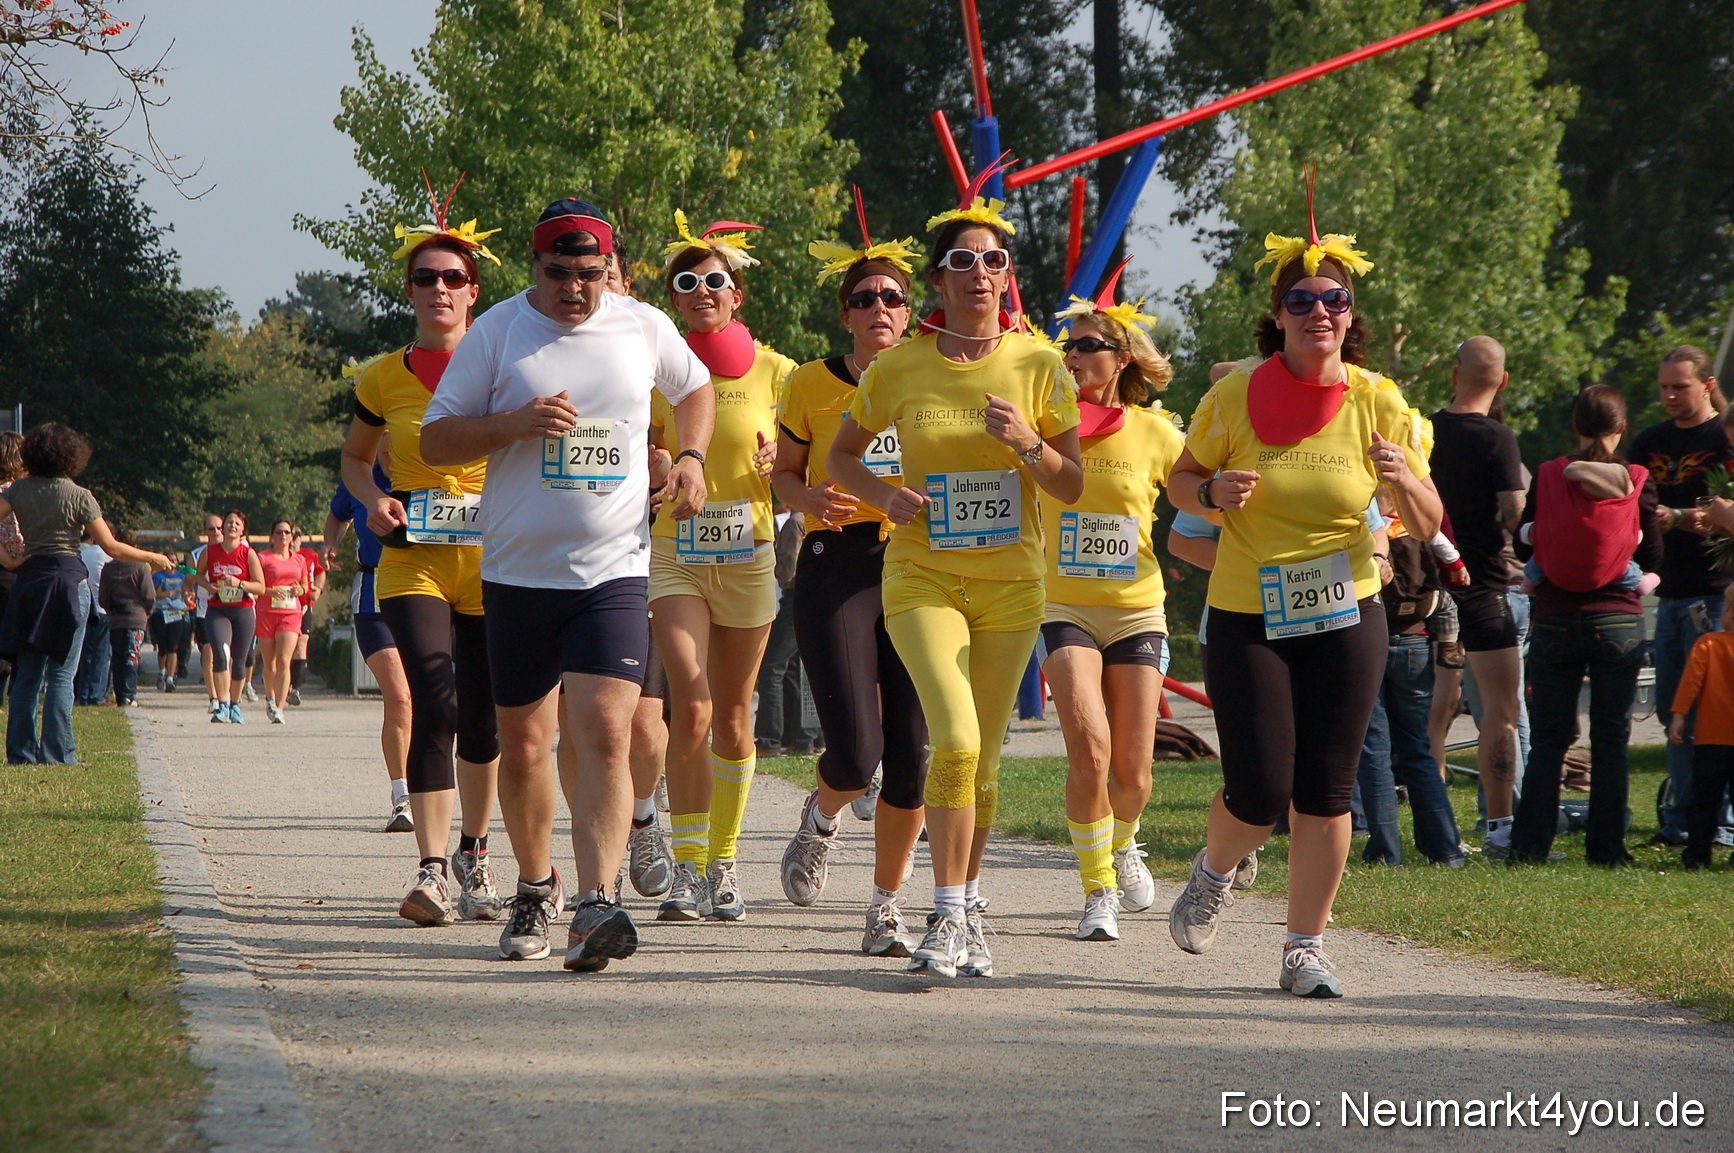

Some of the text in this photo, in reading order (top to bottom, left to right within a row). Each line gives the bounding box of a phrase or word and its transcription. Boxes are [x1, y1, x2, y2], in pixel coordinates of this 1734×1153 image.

[915, 408, 986, 420] BRIGITTEK
[569, 425, 610, 438] Günther
[549, 444, 554, 453] D
[870, 435, 902, 454] 20
[569, 446, 620, 466] 2796
[1258, 450, 1353, 469] BRIGITTEKARL
[953, 478, 1001, 493] Johanna
[413, 504, 419, 512] C
[431, 505, 480, 523] 2717
[697, 505, 743, 519] Alexandra
[934, 501, 939, 512] D
[955, 498, 1012, 521] 3752
[1082, 517, 1120, 533] Siglinde
[698, 523, 745, 543] 2917
[987, 531, 1019, 542] PFLEIDERER
[1081, 536, 1129, 556] 2900
[1286, 567, 1322, 584] Katrin
[1267, 592, 1275, 603] C
[1290, 581, 1346, 610] 2910
[1325, 612, 1359, 626] PFLEIDERER
